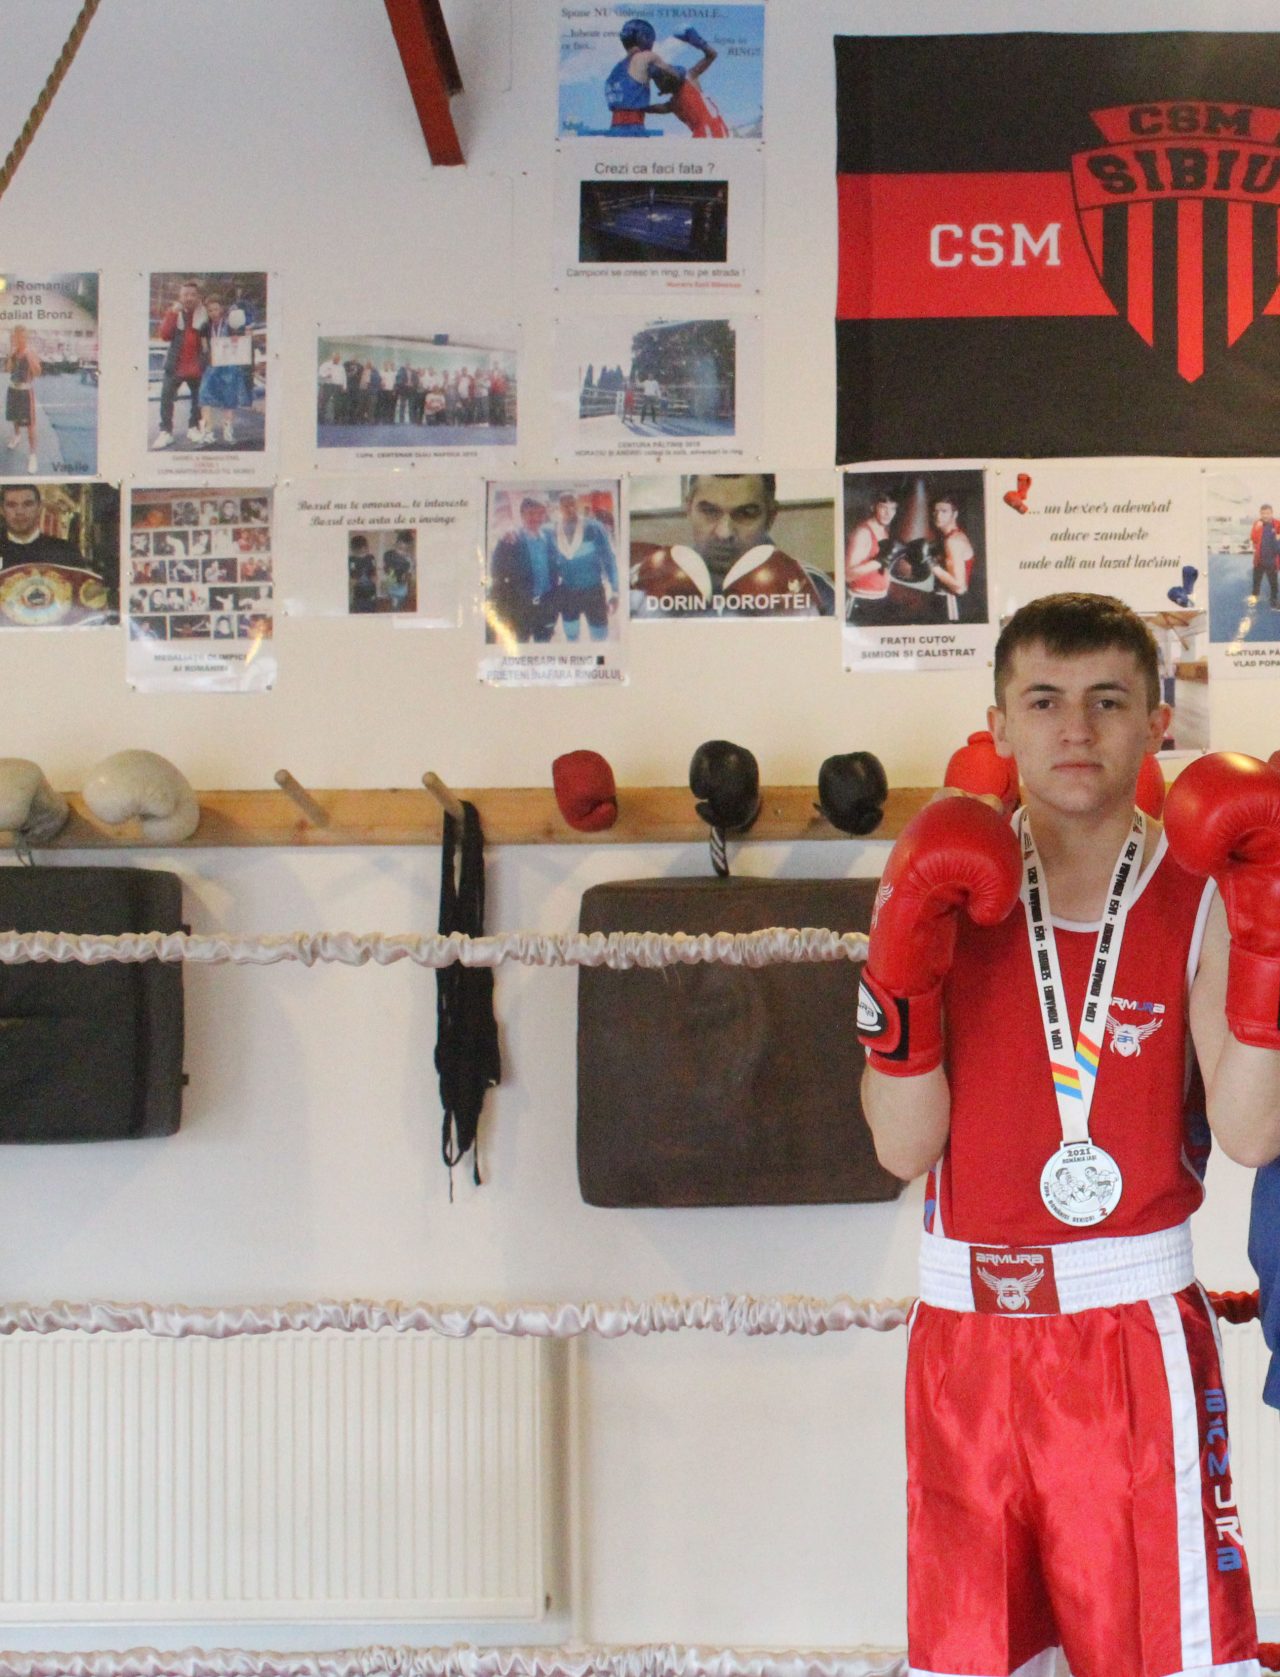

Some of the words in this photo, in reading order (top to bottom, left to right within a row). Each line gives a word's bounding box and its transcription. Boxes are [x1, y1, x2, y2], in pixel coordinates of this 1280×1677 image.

[1128, 103, 1253, 136] CSM
[594, 162, 629, 175] Crezi
[632, 165, 648, 175] ca
[652, 162, 675, 175] faci
[678, 162, 704, 175] fata
[928, 221, 1062, 268] CSM
[12, 294, 43, 306] 2018
[37, 309, 74, 321] Bronz
[51, 461, 89, 474] Vasile
[1044, 504, 1061, 515] un
[1049, 527, 1090, 543] aduce
[1093, 527, 1149, 542] zambete
[1018, 555, 1051, 570] unde
[1079, 560, 1096, 570] au
[645, 594, 708, 612] DORIN
[712, 592, 812, 611] DOROFTEI
[501, 655, 556, 666] ADVERSARI
[570, 655, 593, 665] RING
[861, 650, 900, 660] SIMION
[916, 648, 977, 659] CALISTRAT
[1233, 659, 1257, 668] VLAD
[1111, 996, 1166, 1014] RMURA
[1085, 1002, 1098, 1023] CUPA
[1050, 1028, 1064, 1051] CUPA
[1067, 1147, 1091, 1158] 2021
